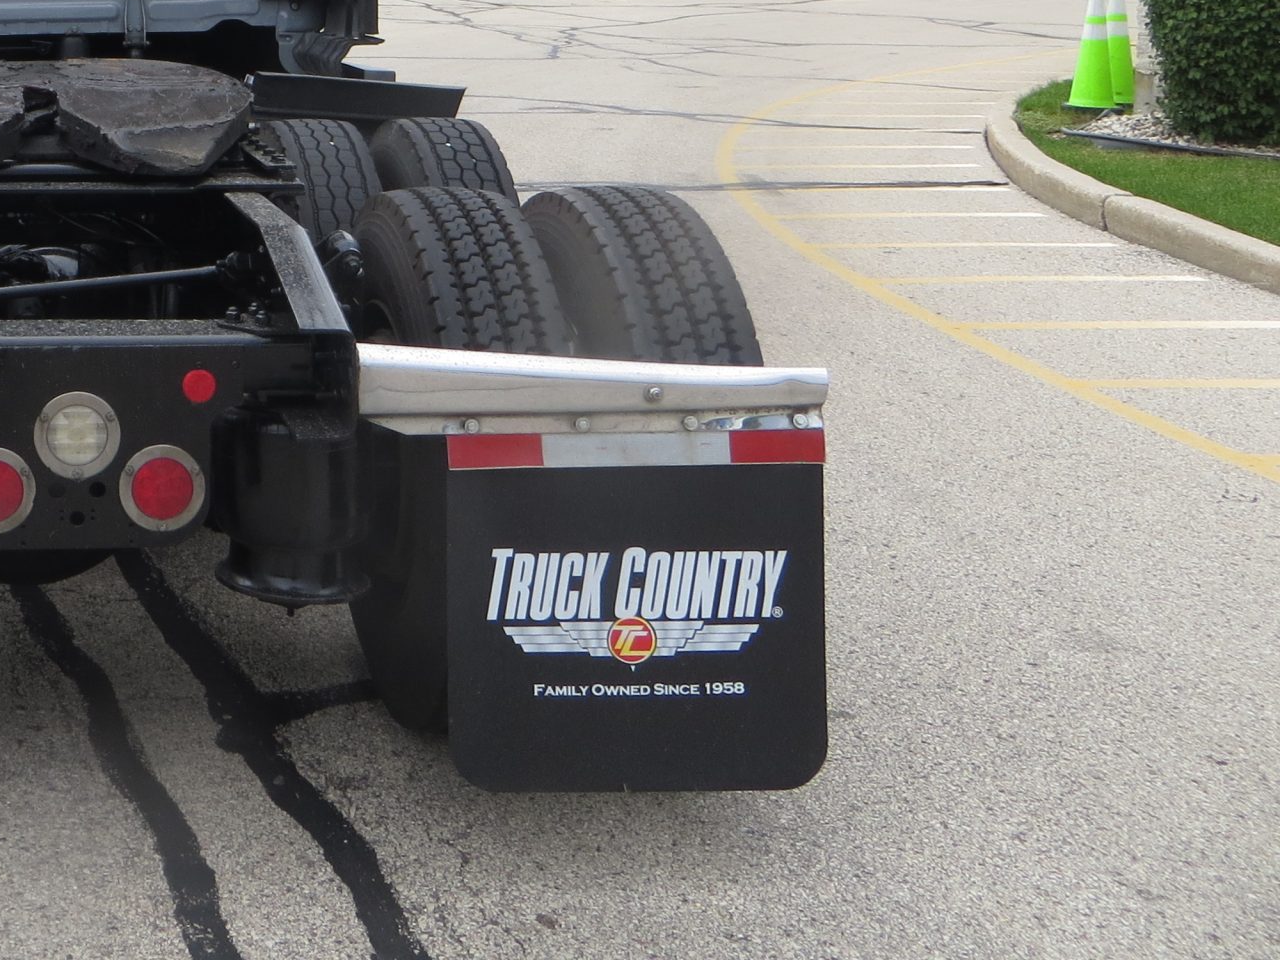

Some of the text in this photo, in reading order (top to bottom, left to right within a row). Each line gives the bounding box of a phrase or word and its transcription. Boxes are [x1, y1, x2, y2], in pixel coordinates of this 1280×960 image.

[486, 548, 610, 621] TRUCK
[611, 625, 650, 656] TC
[533, 681, 745, 697] FAMILY OWNED SINCE 1958
